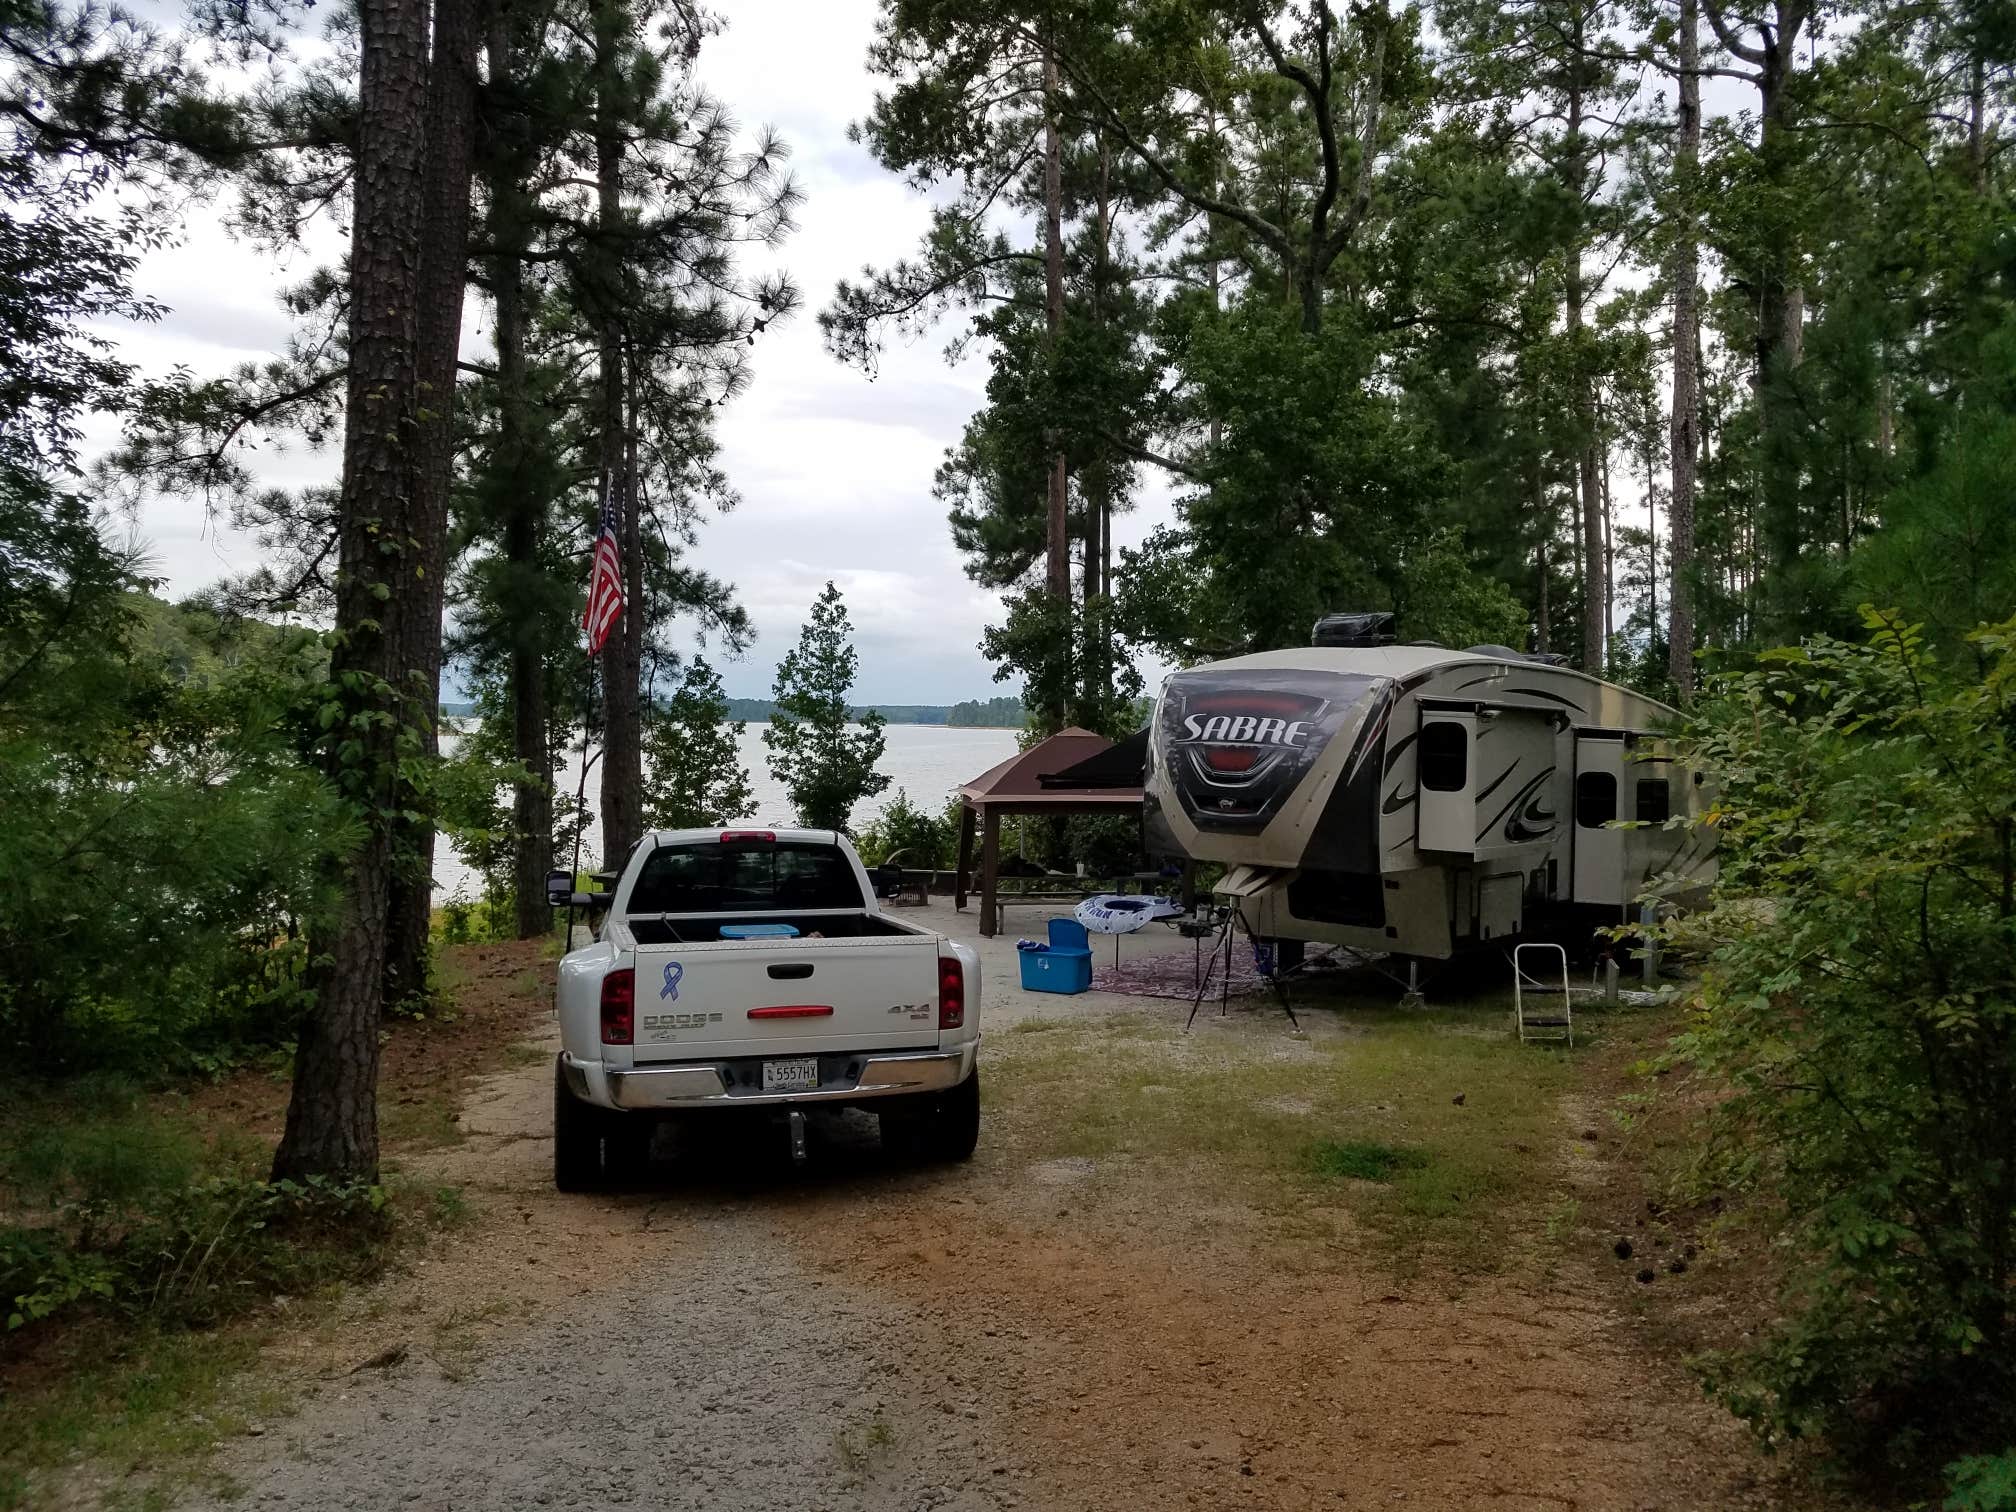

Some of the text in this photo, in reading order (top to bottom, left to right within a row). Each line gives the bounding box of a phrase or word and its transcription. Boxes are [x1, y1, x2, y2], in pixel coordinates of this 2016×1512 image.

[1177, 713, 1314, 748] SABRE
[643, 1012, 723, 1024] DODGE
[776, 1065, 816, 1081] 5557HX
